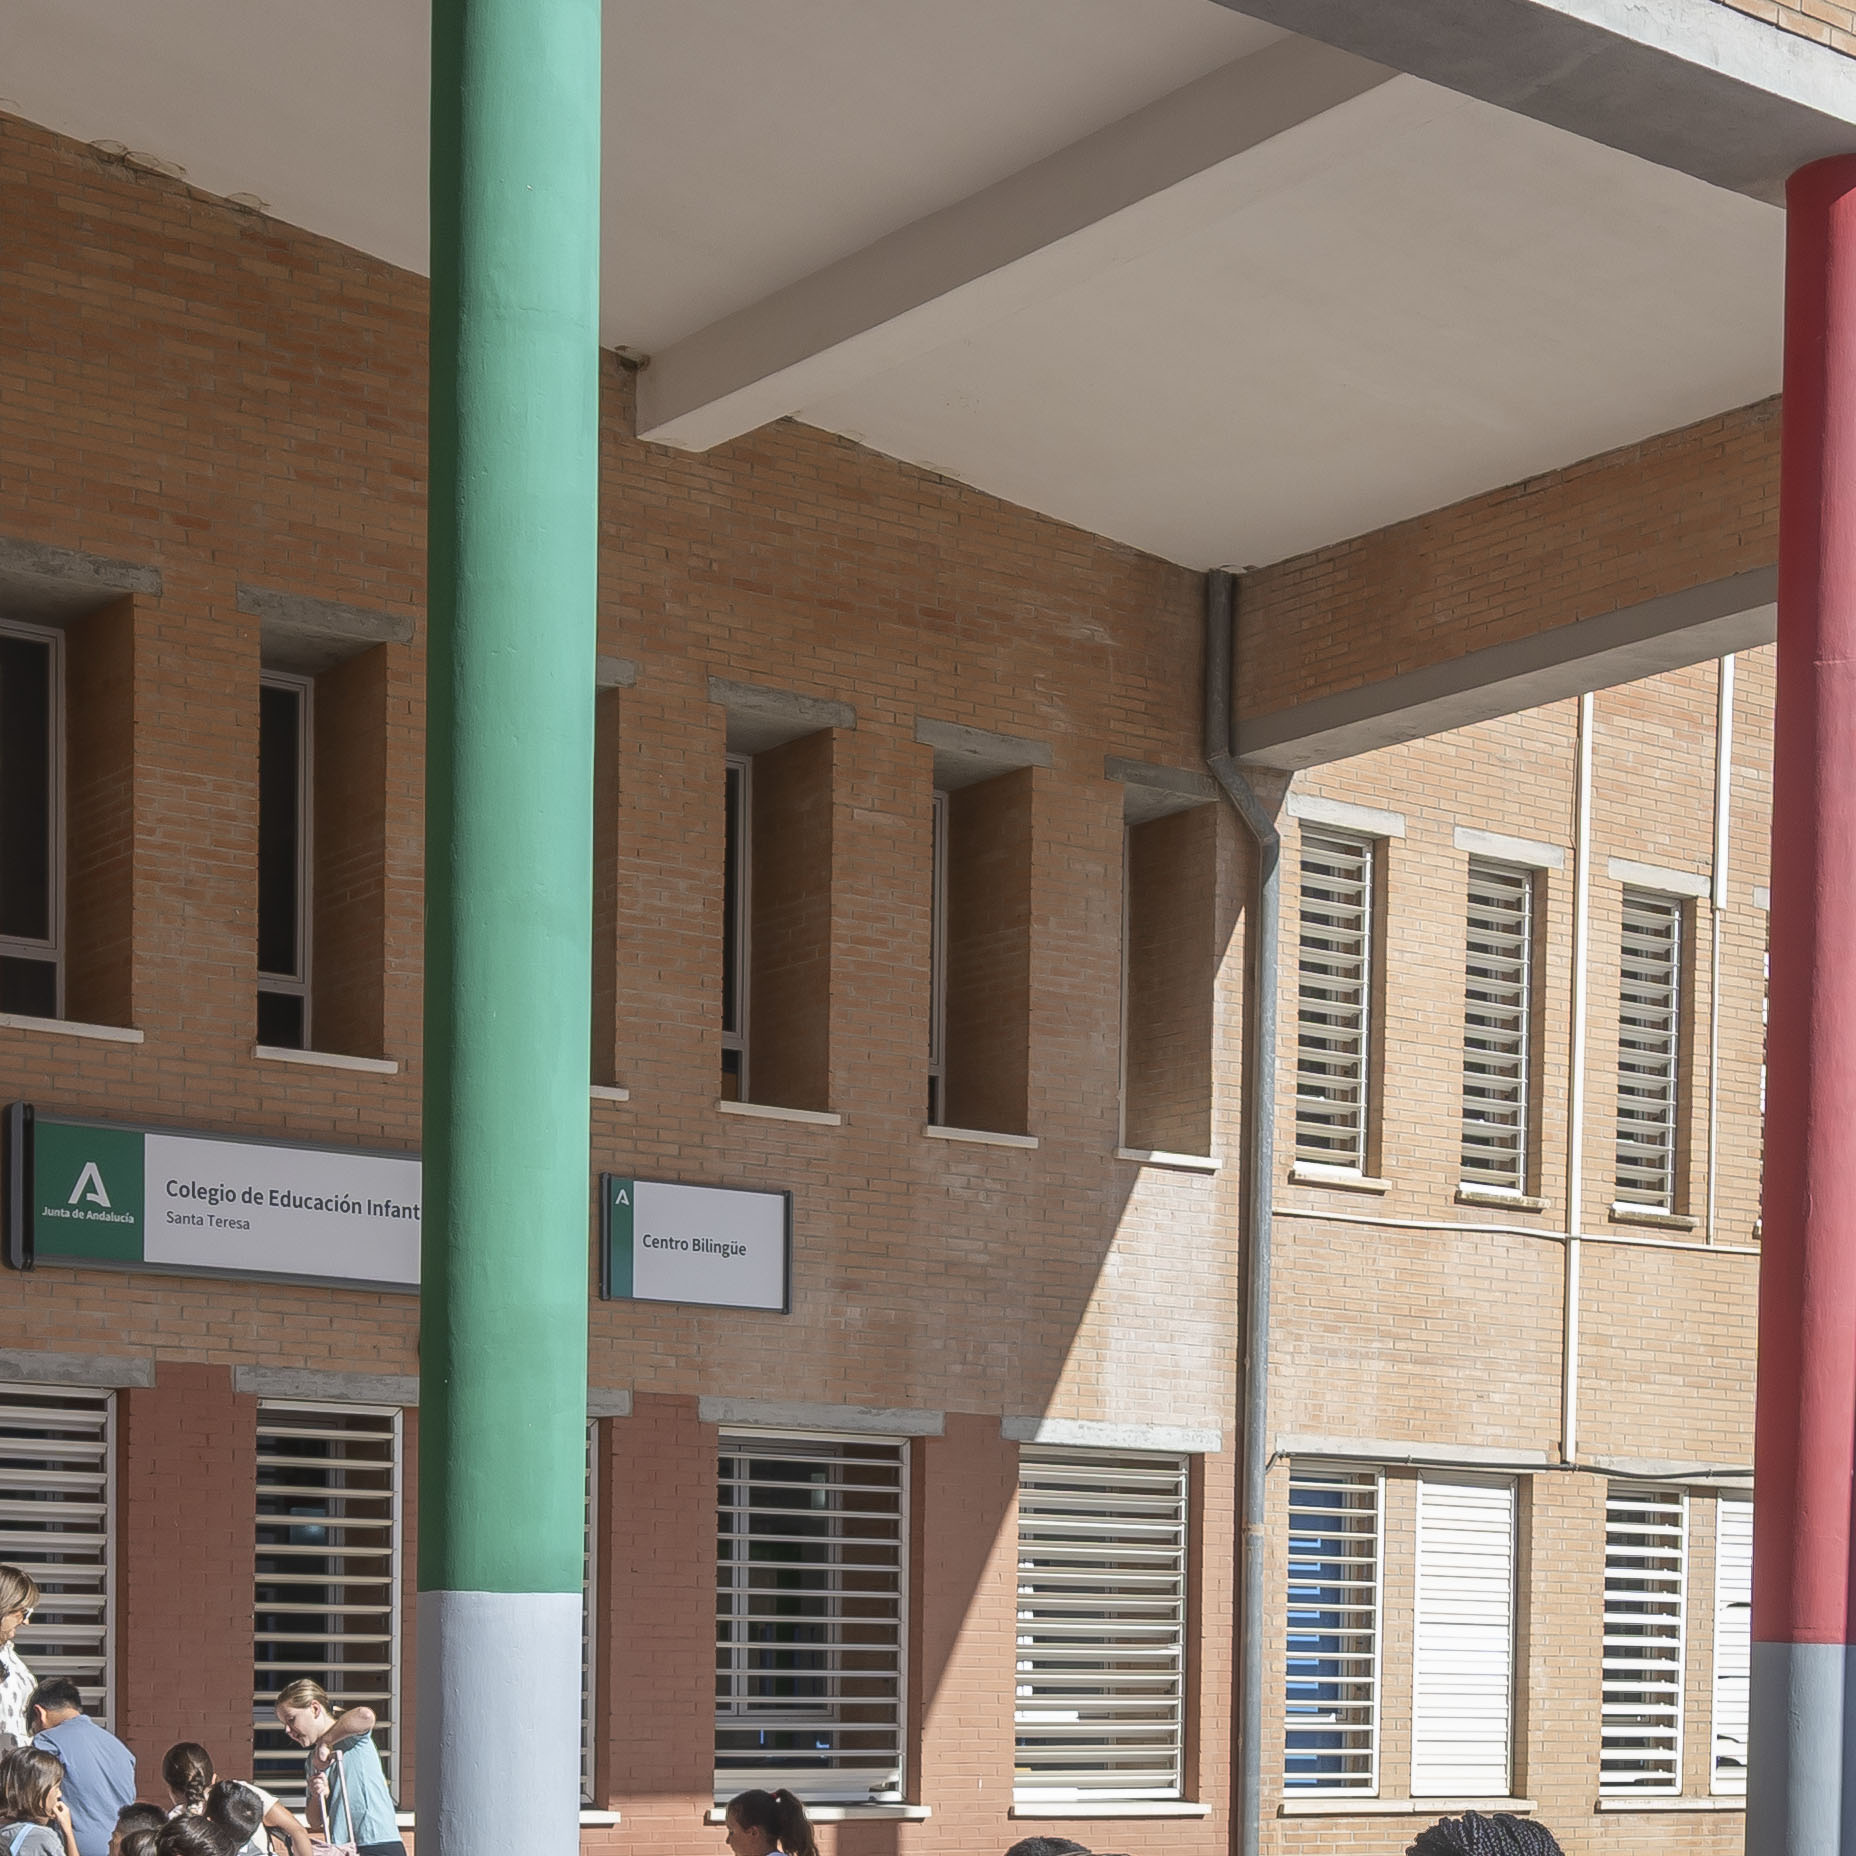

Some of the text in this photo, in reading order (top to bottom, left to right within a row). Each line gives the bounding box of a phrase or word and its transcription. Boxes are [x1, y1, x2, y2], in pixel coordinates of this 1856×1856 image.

[165, 1179, 237, 1205] Colegio
[241, 1186, 264, 1205] de
[269, 1189, 362, 1215] Educación
[41, 1206, 135, 1225] Junta de Andalucía
[165, 1210, 251, 1231] Santa Teresa
[642, 1234, 747, 1258] Centro Bilingüe
